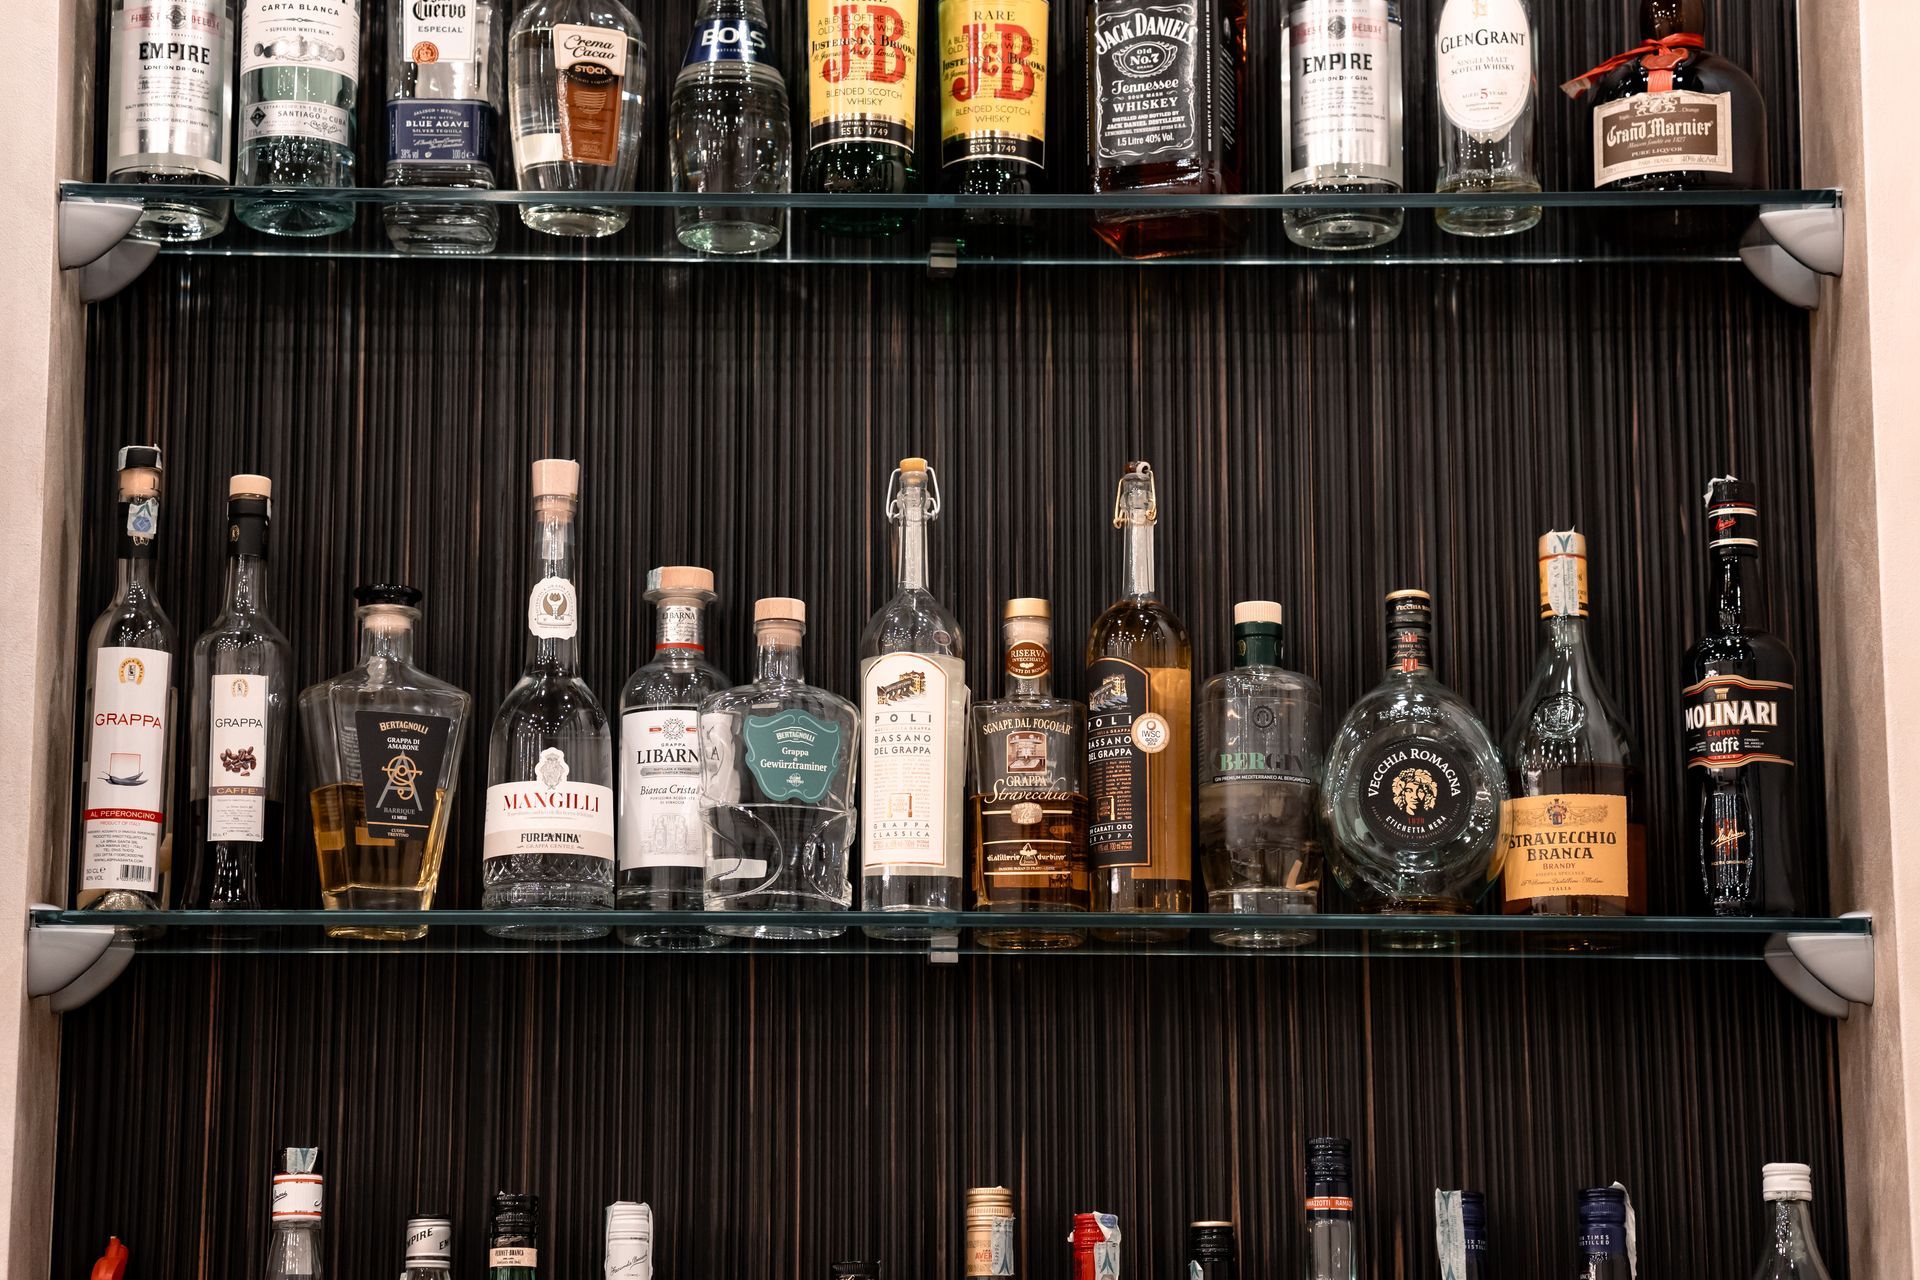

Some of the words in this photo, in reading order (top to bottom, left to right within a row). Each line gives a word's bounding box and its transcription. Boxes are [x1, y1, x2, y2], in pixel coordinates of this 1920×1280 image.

[261, 3, 294, 12] CARTA
[299, 3, 339, 16] BLANCA
[413, 1, 466, 21] Cuervo
[974, 10, 1016, 22] RARE
[418, 26, 463, 34] ESPECIAL
[818, 26, 835, 36] OLD
[563, 35, 615, 50] Crema
[701, 27, 766, 49] BOLS
[1094, 20, 1135, 55] JACK
[139, 41, 210, 65] EMPIRE
[572, 46, 618, 60] Cacao
[947, 45, 964, 55] OLD
[1008, 52, 1045, 73] BROOKS
[1130, 53, 1160, 66] No.7
[1302, 52, 1373, 77] EMPIRE
[574, 65, 607, 75] STOCK
[1450, 65, 1482, 76] SCOTCH
[1483, 63, 1515, 71] WHISKY
[1111, 78, 1179, 95] Tennessee
[826, 87, 865, 98] BLENDED
[867, 87, 903, 100] SCOTCH
[1480, 88, 1489, 100] 5
[847, 98, 883, 106] WHISKY
[1112, 96, 1179, 113] WHISKEY
[955, 105, 993, 116] BLENDED
[995, 105, 1031, 116] SCOTCH
[278, 111, 321, 120] SANTIAGO
[328, 116, 346, 125] CUBA
[975, 115, 1011, 123] WHISKY
[1106, 122, 1123, 130] JACK
[1123, 120, 1148, 129] DANIEL
[1148, 116, 1186, 126] DISTILLERY
[1112, 115, 1137, 123] DISTILLED
[868, 127, 889, 136] 1749
[1606, 121, 1647, 148] Grand
[1646, 117, 1713, 139] Marnier
[1128, 136, 1144, 146] Litre
[1145, 133, 1161, 143] 40%
[1162, 132, 1175, 141] Vol.
[996, 144, 1016, 153] 1749
[1631, 150, 1651, 158] PURE
[1010, 649, 1046, 659] RISERVA
[95, 713, 162, 730] GRAPPA
[875, 713, 932, 724] POLI
[1685, 700, 1778, 732] MOLINARI
[215, 718, 264, 729] GRAPPA
[379, 720, 429, 735] BERTAGNOLLI
[983, 718, 1014, 736] SGNAPE
[1014, 718, 1032, 729] DAL
[1088, 715, 1132, 731] POLI
[775, 731, 816, 743] BERTAGNOLLI
[874, 734, 931, 744] BASSANO
[1141, 730, 1161, 738] IWSC
[1707, 729, 1740, 737] Liquore
[386, 736, 412, 744] GRAPPA
[1088, 735, 1132, 750] BASSANO
[1710, 736, 1740, 753] caffè
[387, 743, 420, 752] AMARONE
[782, 747, 809, 757] Grappa
[874, 747, 889, 756] DEL
[891, 746, 931, 755] GRAPPA
[1088, 751, 1097, 762] DEL
[1097, 747, 1133, 759] GRAPPA
[760, 758, 828, 772] Gewürztraminer
[1368, 751, 1408, 797] VECCHIA
[1410, 748, 1461, 797] ROMAGNA
[1006, 775, 1047, 787] GRAPPA
[1284, 776, 1311, 784] BERGAMOTTO
[640, 785, 668, 796] Bianca
[984, 777, 1071, 804] Stravecchia
[503, 792, 599, 813] MANGILLI
[100, 810, 156, 820] PEPERONCINO
[383, 807, 416, 816] BARRIQUE
[873, 822, 930, 830] GRAPPA
[1094, 825, 1114, 834] CARATI
[1385, 815, 1426, 834] ETICHETTA
[1428, 815, 1447, 831] NERA
[520, 832, 580, 844] FURLANINA
[873, 831, 930, 839] CLASSICA
[1508, 831, 1617, 849] STRAVECCHIO
[1527, 847, 1594, 862] BRANCA
[975, 1252, 993, 1260] AVER
